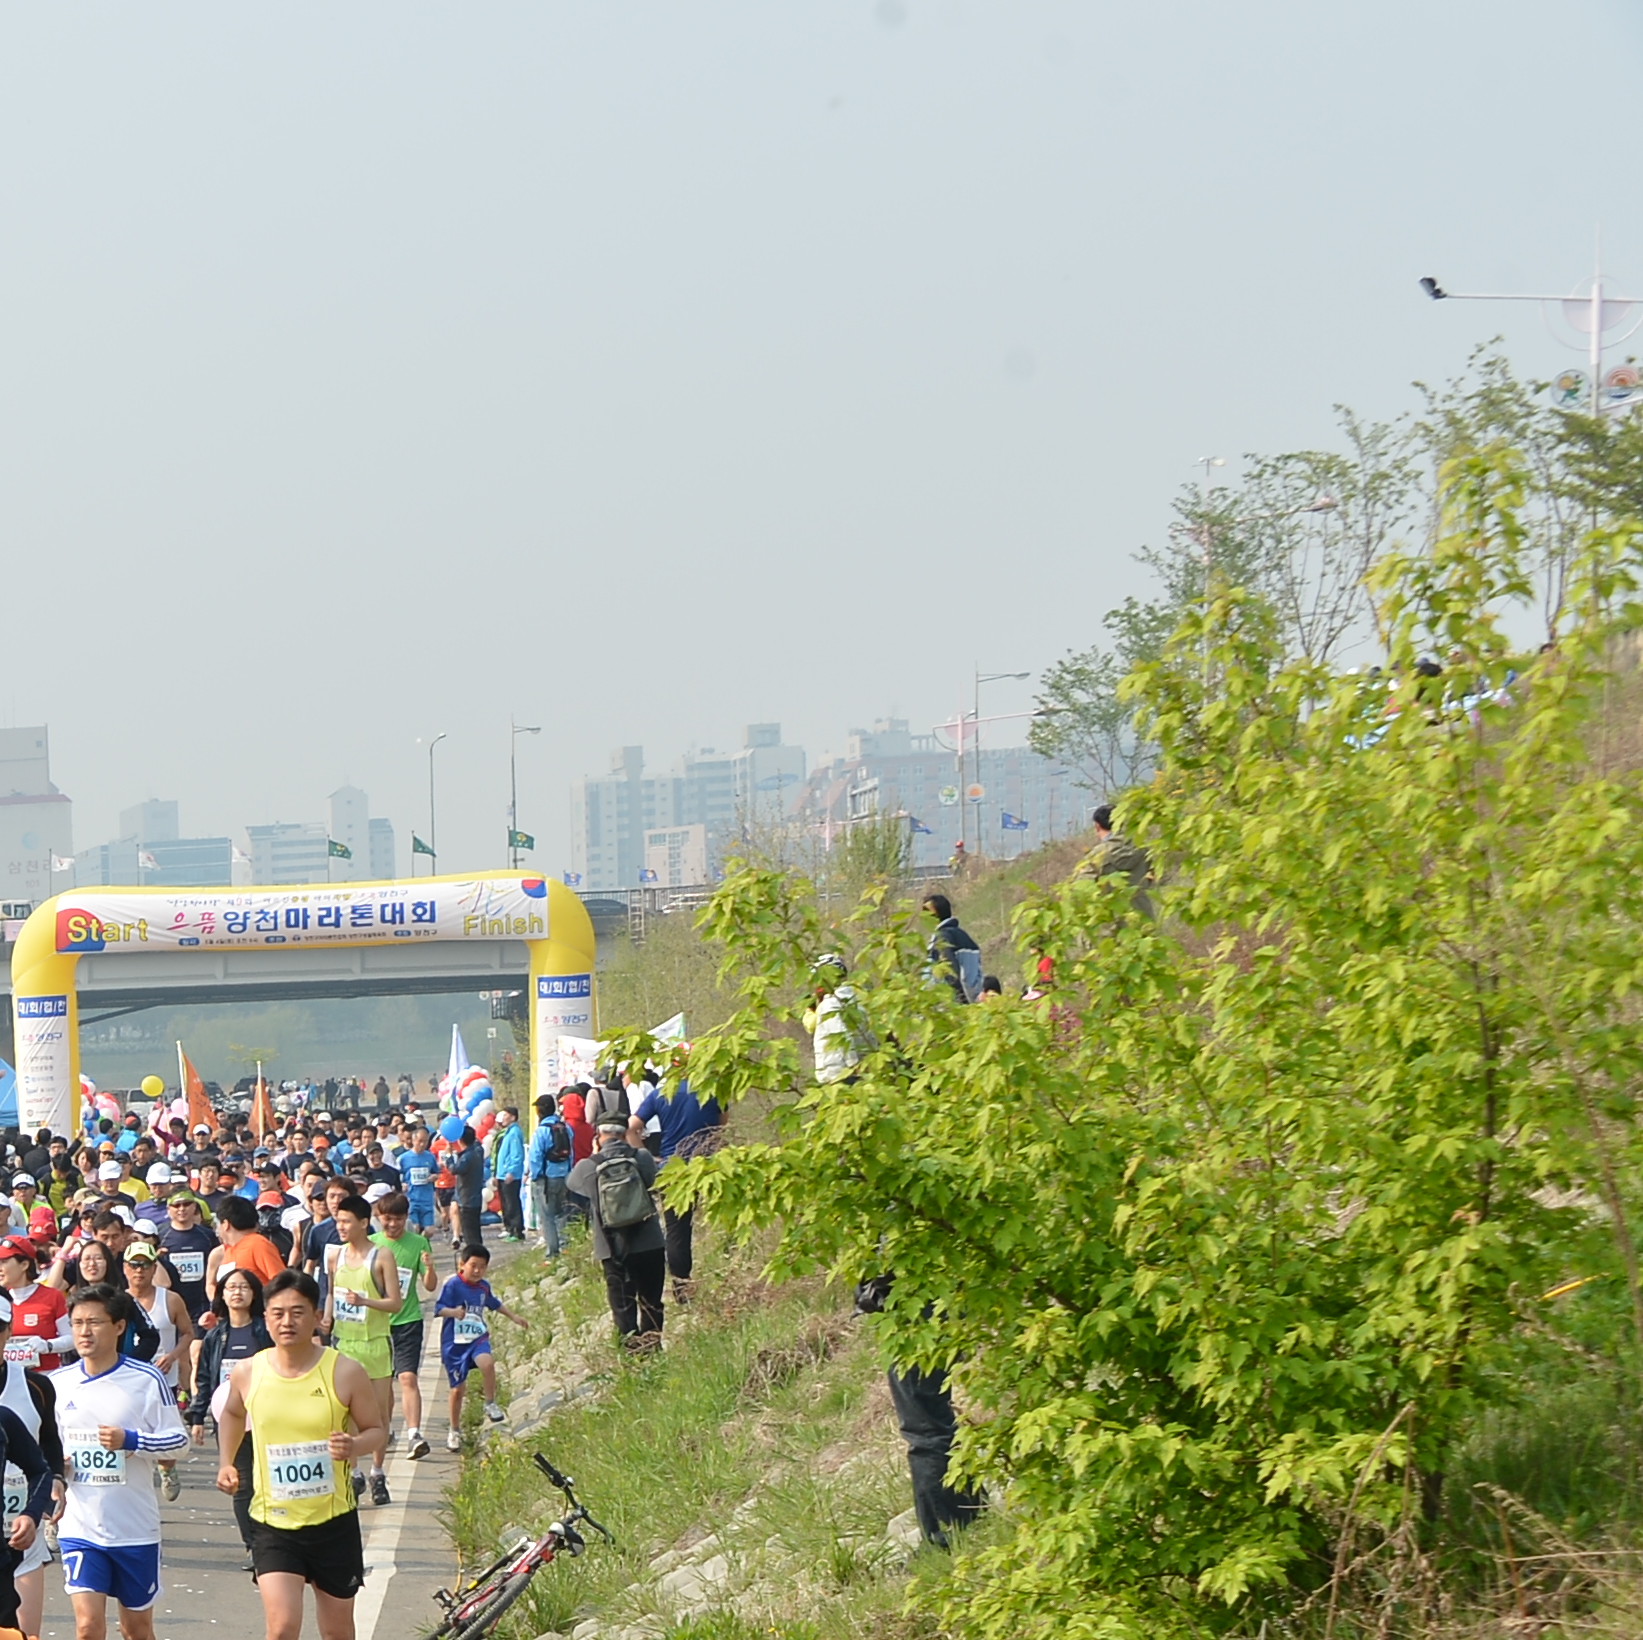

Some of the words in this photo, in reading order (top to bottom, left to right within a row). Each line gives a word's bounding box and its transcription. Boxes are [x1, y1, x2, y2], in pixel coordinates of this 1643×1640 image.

[67, 916, 149, 943] Start
[166, 911, 217, 935] 으뜸
[223, 900, 437, 935] 양천마라톤대회
[463, 911, 544, 936] Finish
[71, 1450, 117, 1469] 1362
[92, 1475, 120, 1483] FITNESS
[274, 1461, 326, 1484] 1004
